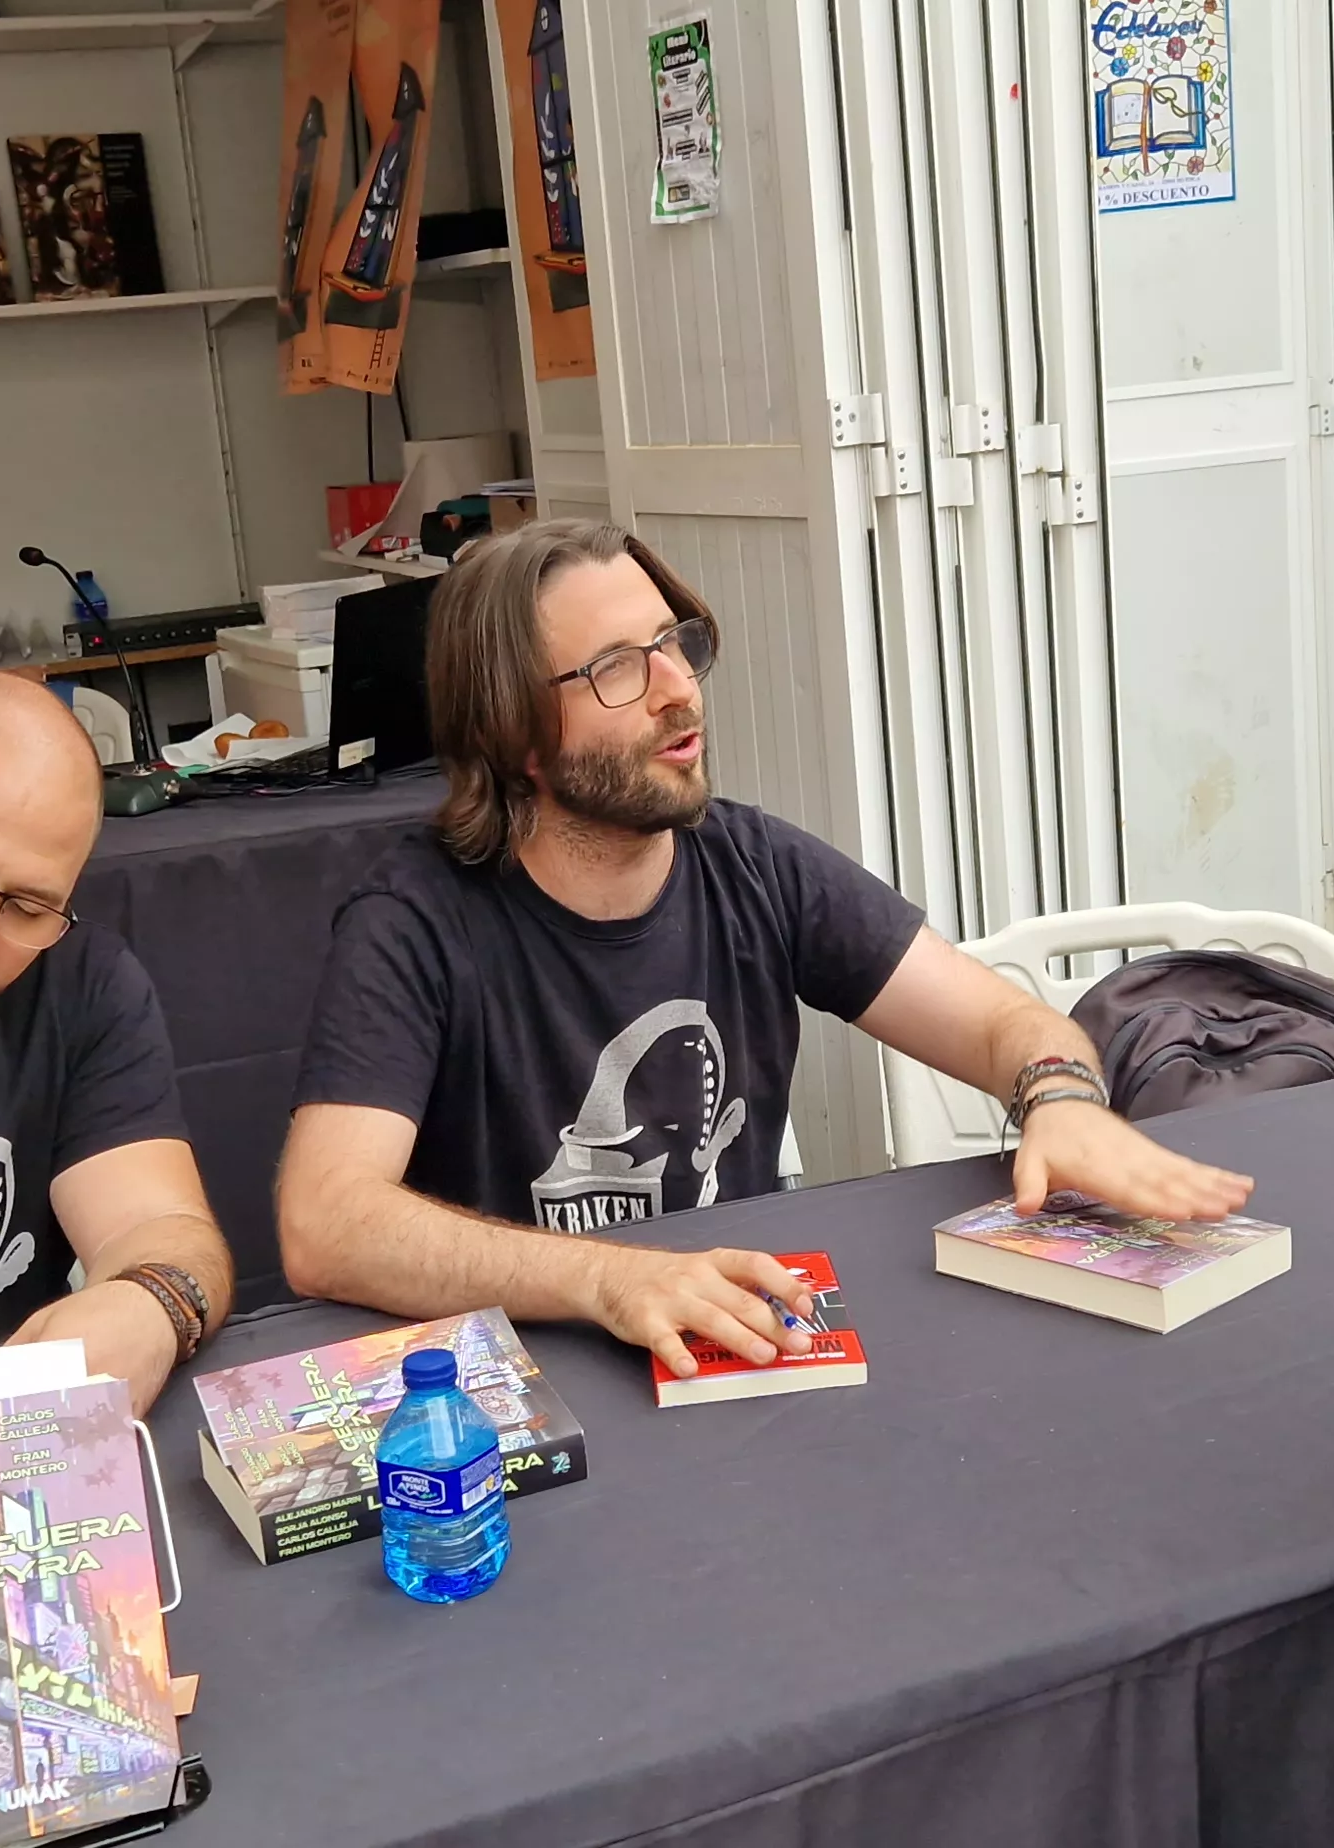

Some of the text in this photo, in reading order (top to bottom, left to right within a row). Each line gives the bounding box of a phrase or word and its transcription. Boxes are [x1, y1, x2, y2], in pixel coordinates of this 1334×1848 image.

[1123, 185, 1209, 204] DESCUENTO
[544, 1196, 646, 1234] KRAKEN
[332, 1369, 372, 1427] ZYRA
[0, 1408, 55, 1426] CARLOS
[299, 1353, 378, 1482] LA CEGUERA
[13, 1449, 50, 1464] FRAN
[0, 1461, 68, 1482] MONTERO
[401, 1474, 429, 1487] MONTE
[274, 1503, 331, 1524] ALEJANDRO
[275, 1510, 348, 1536] BORJA ALONSO
[277, 1519, 359, 1547] CARLOS CALLEJA
[278, 1532, 352, 1558] FRAN MONTERO
